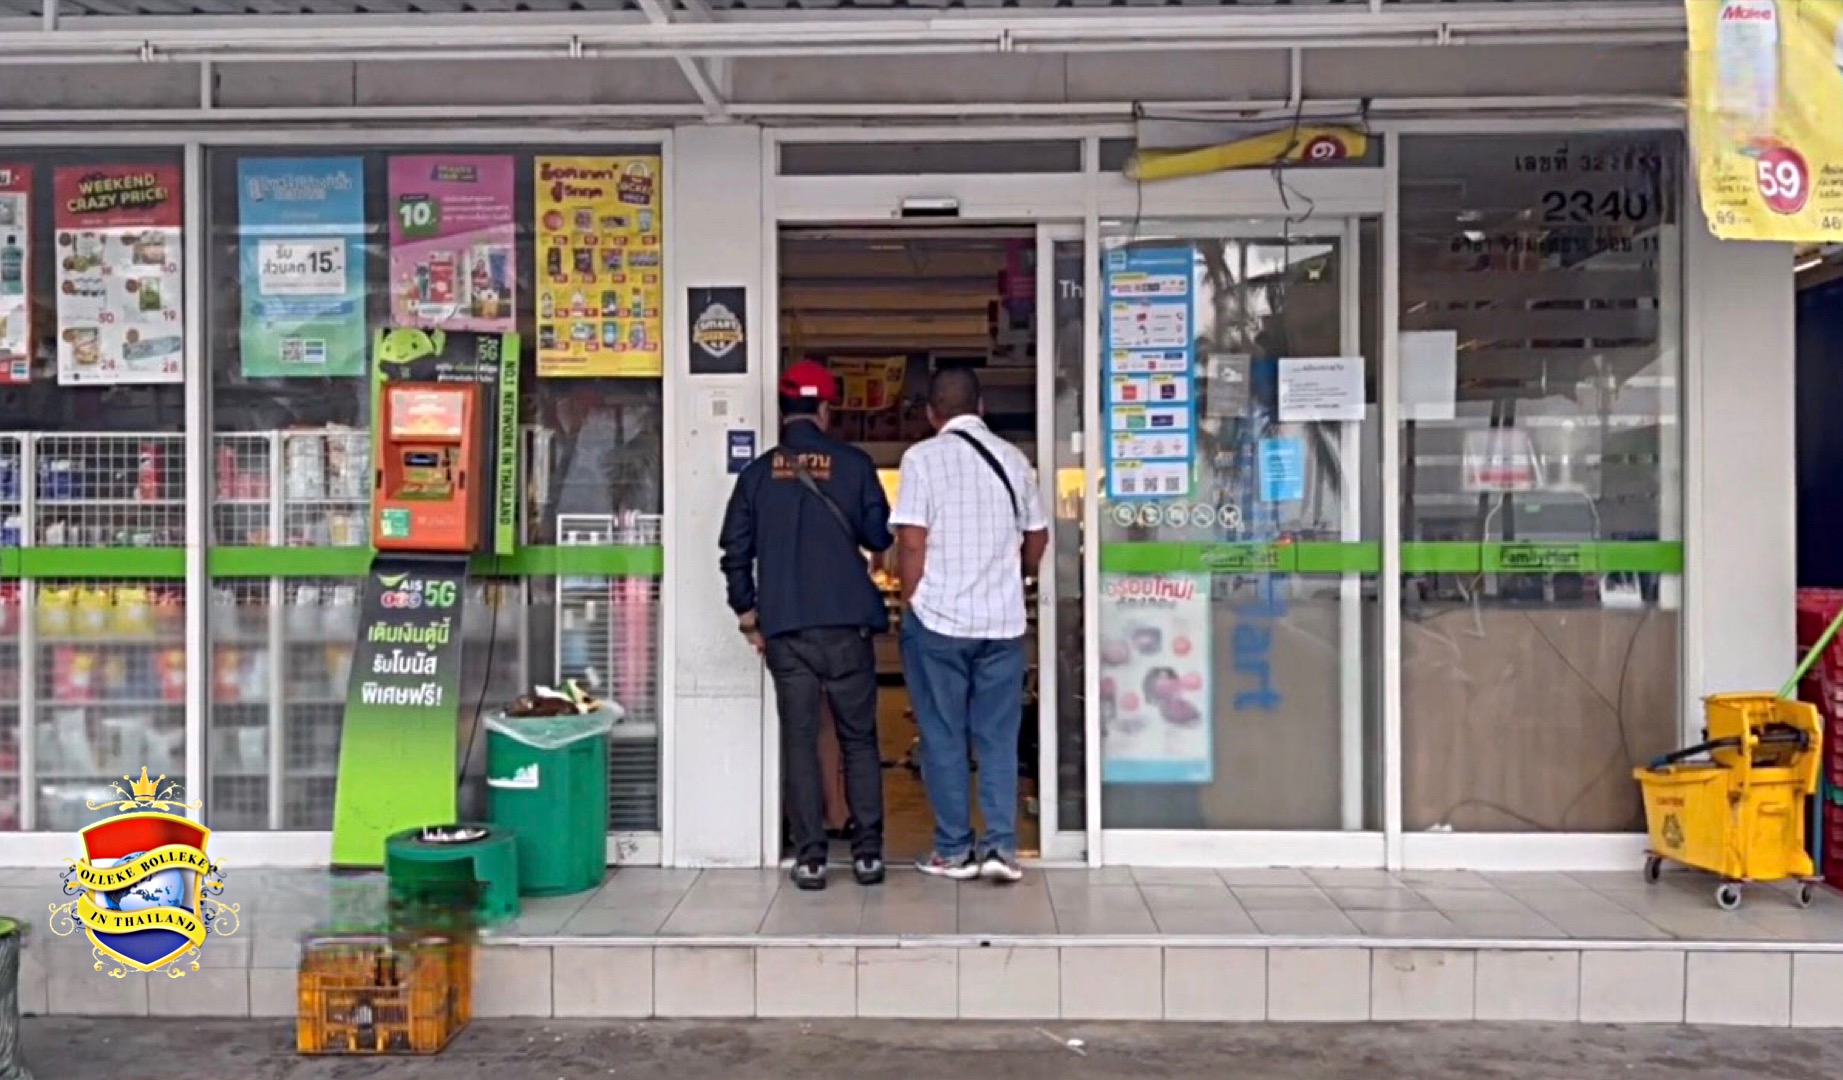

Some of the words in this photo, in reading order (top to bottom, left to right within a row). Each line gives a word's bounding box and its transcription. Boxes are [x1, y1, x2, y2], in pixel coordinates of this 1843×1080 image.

[1721, 5, 1773, 21] Malee
[1514, 143, 1568, 172] เลขที่
[79, 172, 155, 194] WEEKEND
[1757, 160, 1801, 199] 59
[67, 194, 117, 212] CRAZY
[121, 186, 168, 205] PRICE!
[1542, 189, 1649, 222] 2340
[478, 344, 498, 361] 5G
[502, 391, 515, 448] NETWORK
[502, 452, 514, 468] IN
[500, 471, 514, 525] THAILAND
[1500, 546, 1580, 568] FamilyMart
[399, 579, 423, 591] AIS
[425, 579, 457, 609] 5G
[367, 617, 452, 651] เติมเงินตู้นี้
[372, 649, 438, 676] รับโบนัส
[361, 682, 443, 707] พิเศษฟรี!
